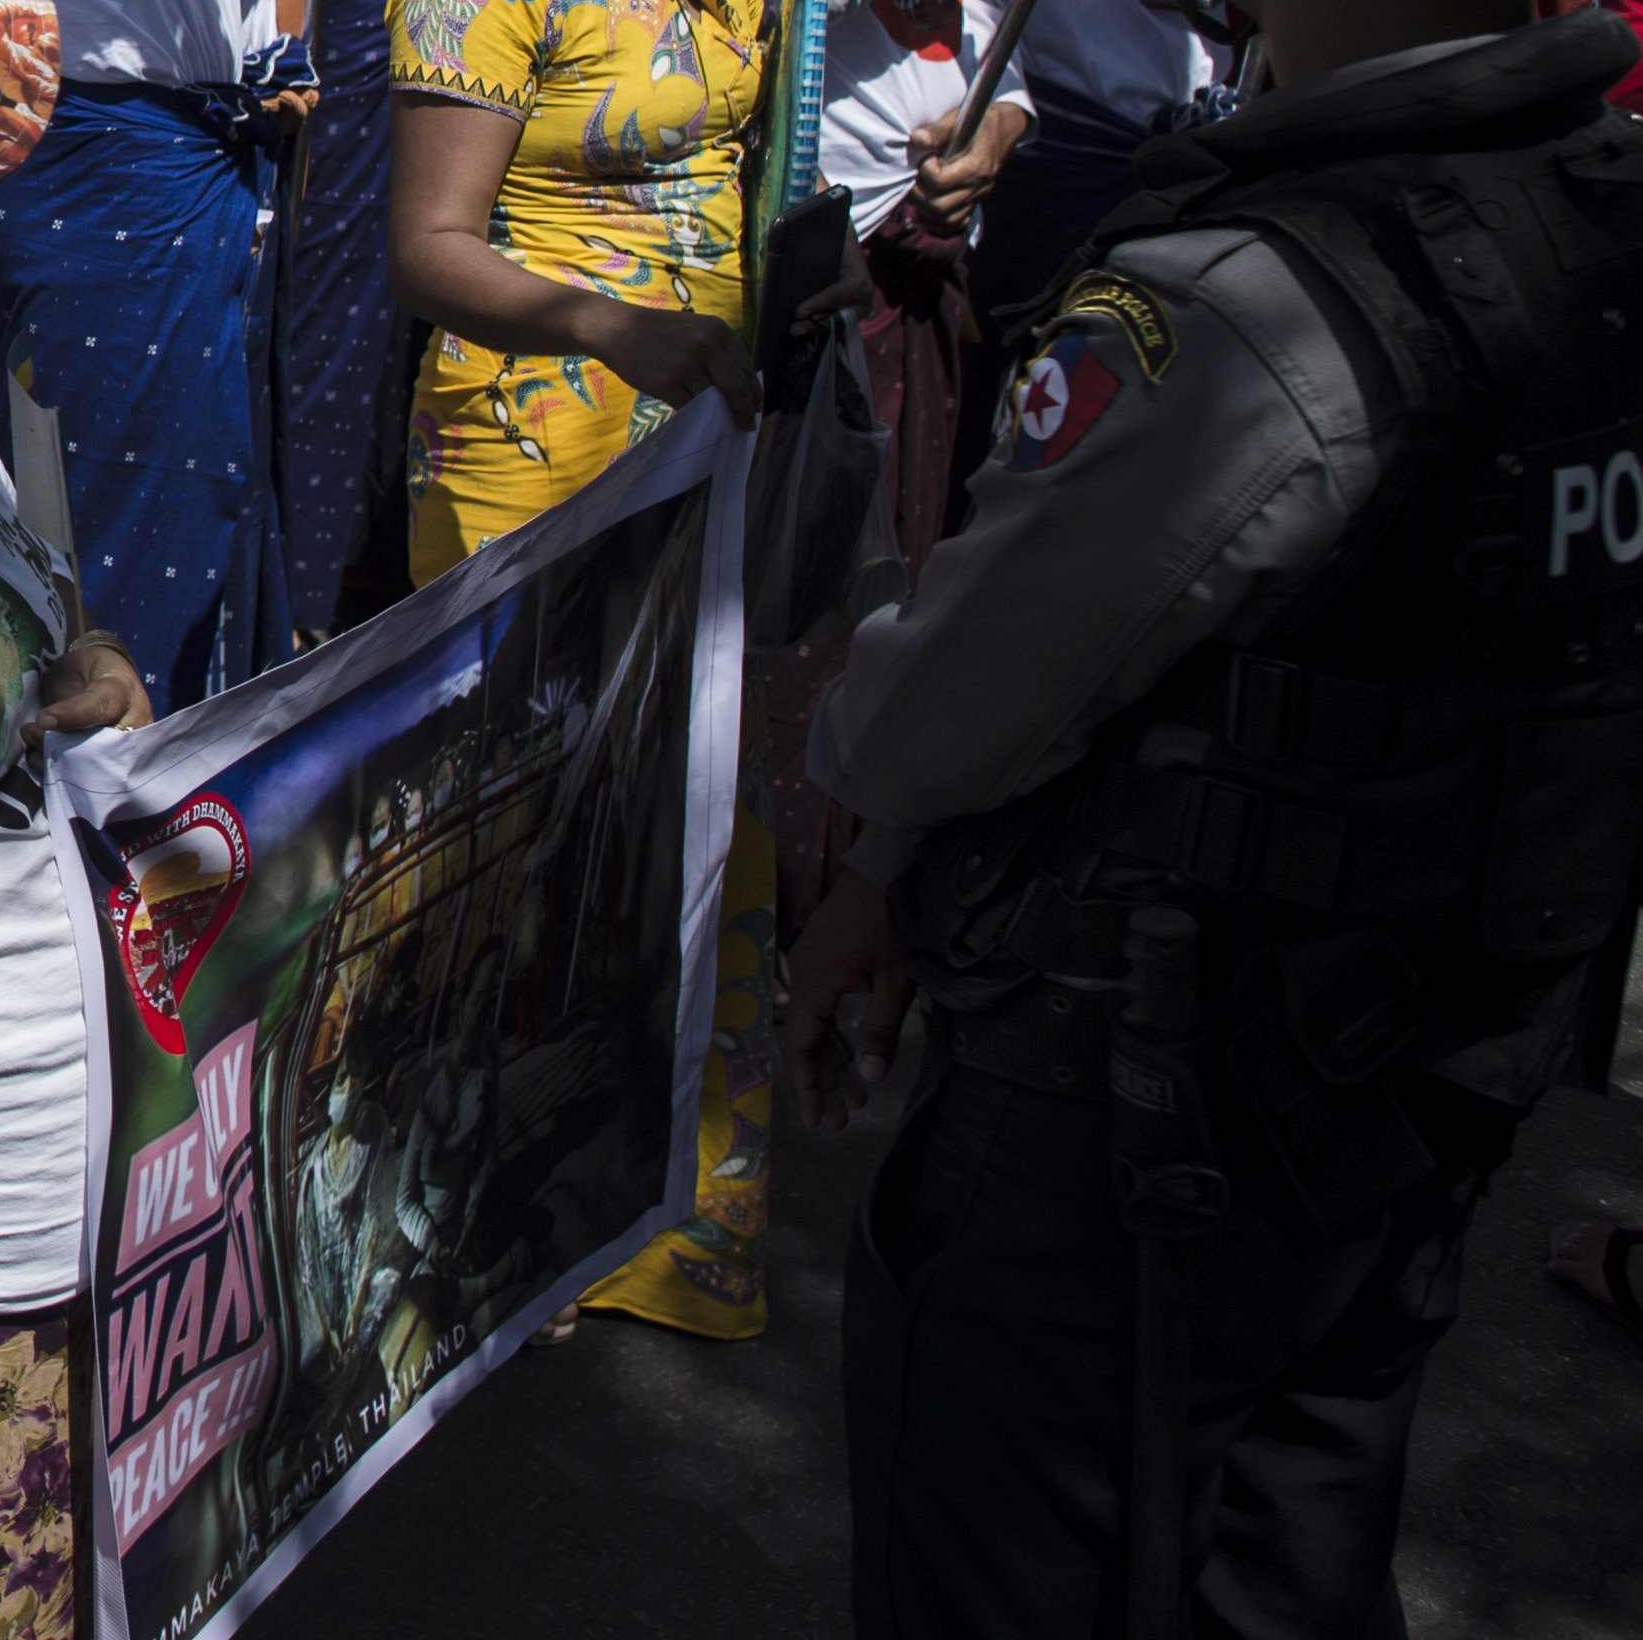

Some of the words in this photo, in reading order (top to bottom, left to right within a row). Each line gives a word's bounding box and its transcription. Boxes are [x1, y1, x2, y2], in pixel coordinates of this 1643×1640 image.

[191, 800, 247, 886] DHAMMAKAYA
[135, 1130, 199, 1247] WE
[151, 1532, 260, 1640] MAKAYA
[357, 1324, 467, 1435] THAILAND
